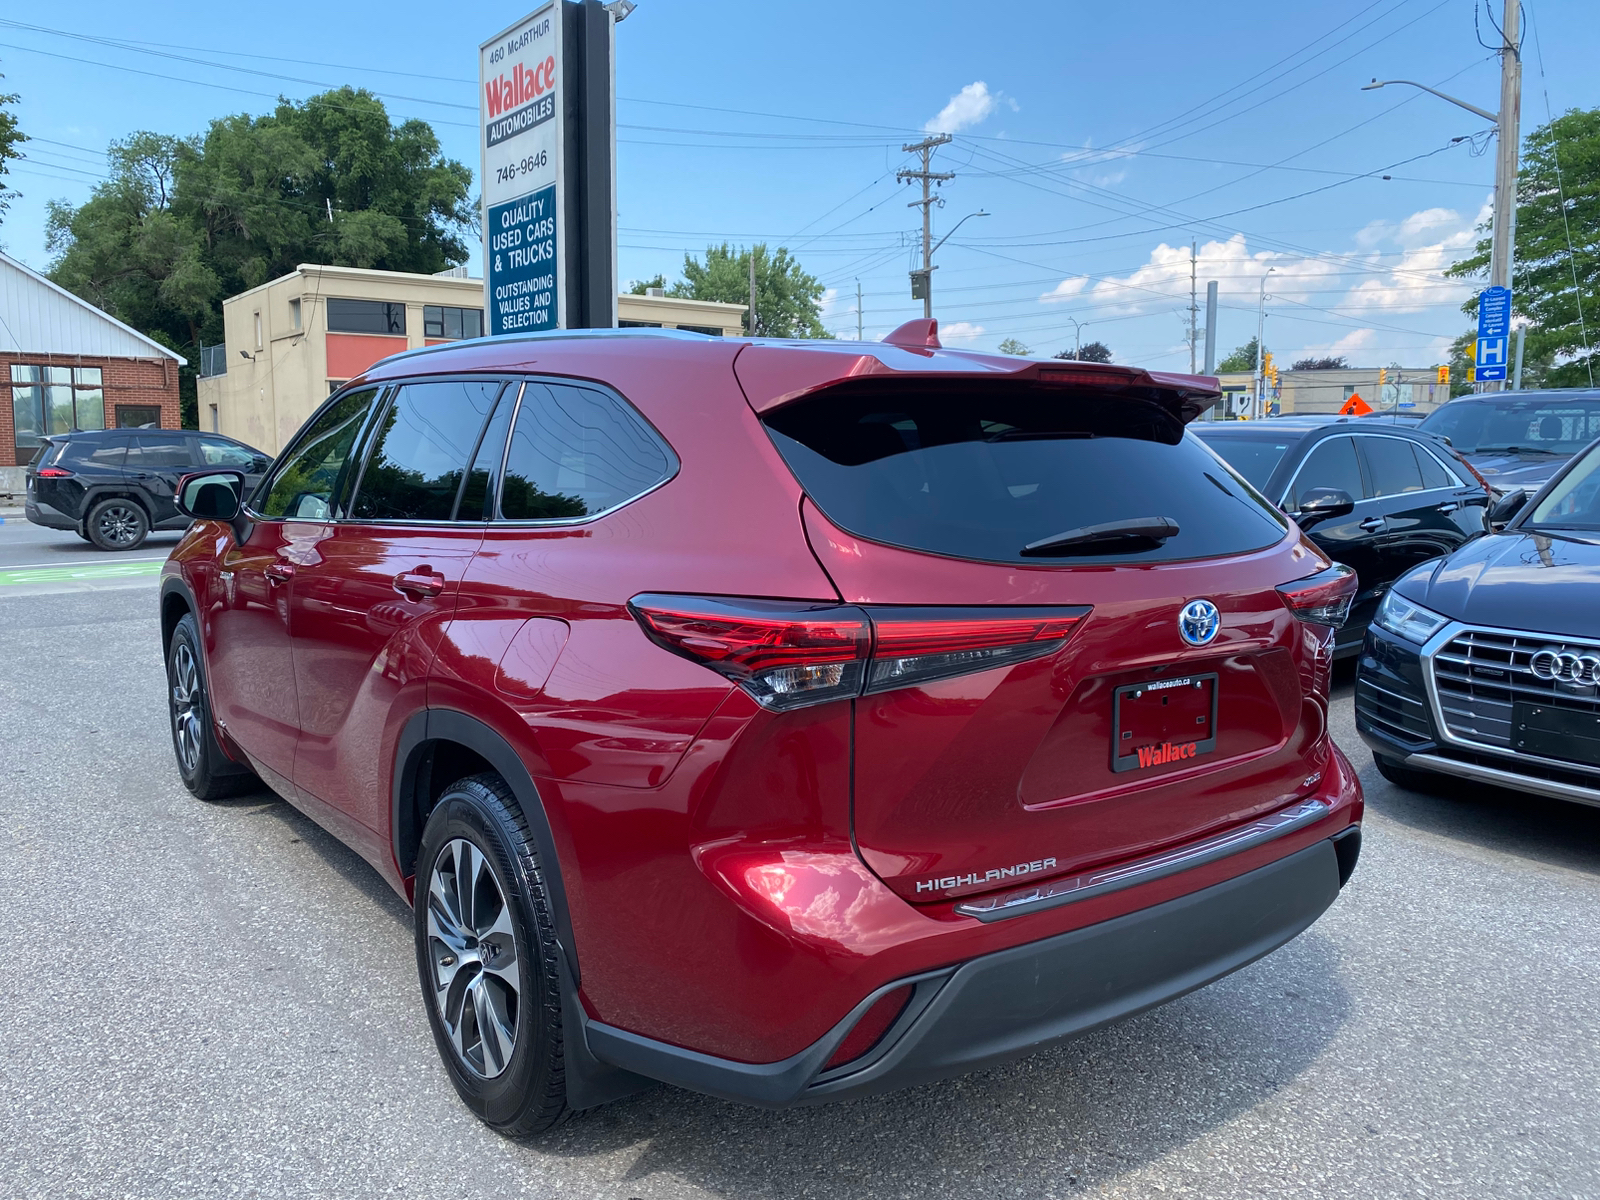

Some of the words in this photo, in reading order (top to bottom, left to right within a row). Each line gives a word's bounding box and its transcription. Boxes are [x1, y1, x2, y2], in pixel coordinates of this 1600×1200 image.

[489, 46, 505, 65] 460
[507, 18, 550, 56] McARTHUR
[485, 55, 555, 118] Wallace
[490, 97, 552, 142] AUTOMOBILES
[496, 149, 547, 184] 746-9646
[501, 198, 544, 228] QUALITY
[493, 228, 522, 251] USED
[526, 216, 554, 242] CARS
[494, 254, 502, 272] &
[508, 239, 553, 269] TRUCKS
[495, 273, 553, 300] OUTSTANDING
[499, 296, 530, 314] VALUES
[533, 291, 551, 308] AND
[502, 308, 548, 330] SELECTION
[1481, 339, 1503, 364] H
[1147, 678, 1191, 691] wallaceauto.ca
[1137, 742, 1197, 768] Wallace
[916, 856, 1057, 893] HIGHLANDER
